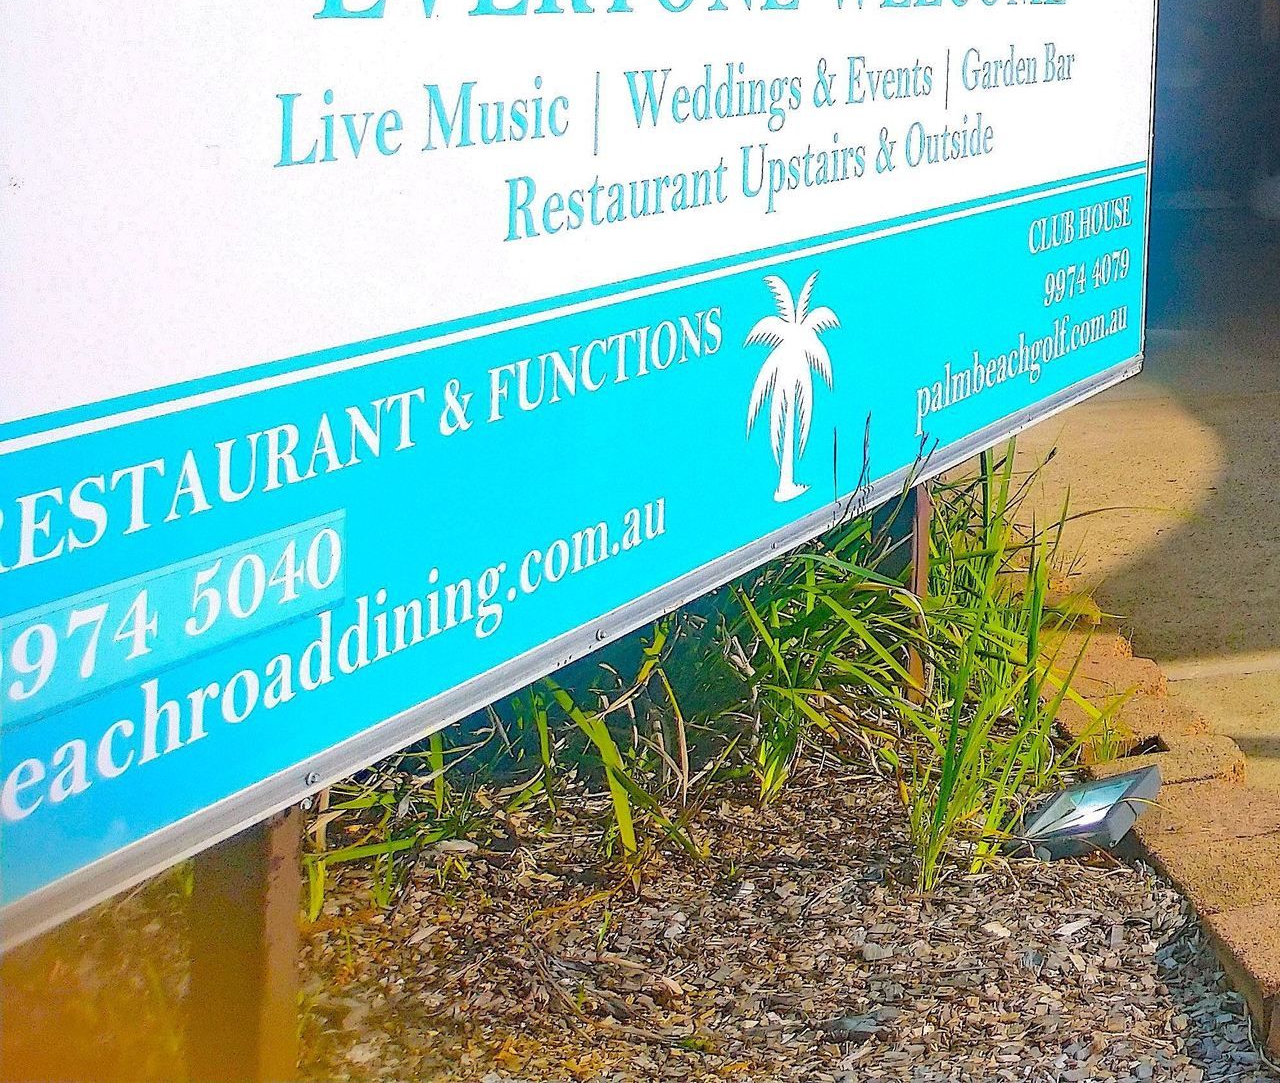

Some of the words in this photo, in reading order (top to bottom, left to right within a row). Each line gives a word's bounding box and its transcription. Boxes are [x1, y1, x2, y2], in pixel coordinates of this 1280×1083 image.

[274, 88, 404, 169] Live
[422, 75, 569, 152] Music
[624, 61, 802, 133] Weddings
[813, 57, 837, 109] &
[845, 55, 933, 105] Events
[961, 44, 1038, 92] Garden
[1043, 42, 1076, 83] Bar
[504, 156, 729, 243] Restaurant
[740, 126, 866, 215] Upstairs
[876, 126, 897, 175] &
[905, 113, 993, 168] Outside
[1028, 209, 1075, 254] CLUB
[1079, 195, 1132, 240] HOUSE
[1043, 262, 1087, 307] 9974
[1091, 248, 1130, 289] 4079
[914, 305, 1128, 437] palmbeachgolf.com.au
[0, 387, 425, 574] ESTAURANT
[440, 378, 472, 436] &
[488, 307, 722, 423] FUNCTIONS
[0, 588, 158, 701] 974
[185, 527, 342, 637] 5040
[0, 497, 667, 821] eachroaddining.com.au
